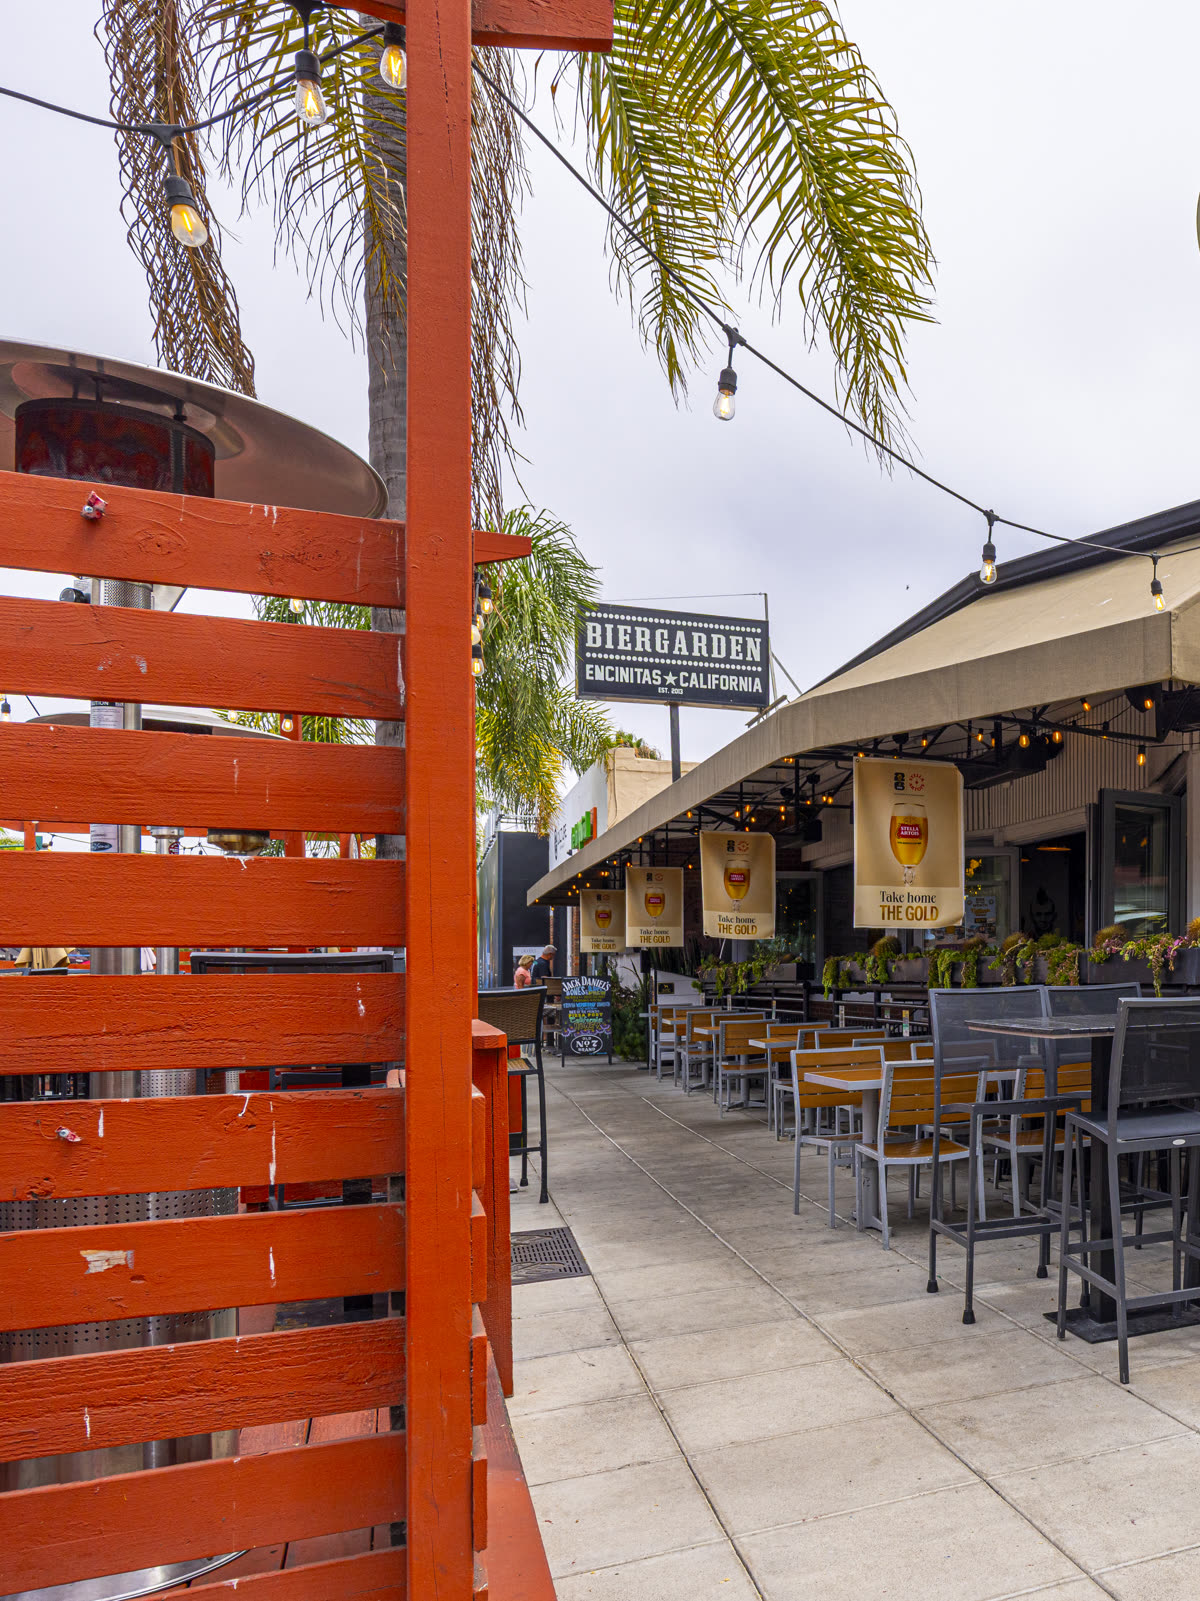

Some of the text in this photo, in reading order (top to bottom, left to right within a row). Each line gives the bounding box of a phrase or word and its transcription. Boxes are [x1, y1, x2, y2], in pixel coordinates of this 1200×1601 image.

[585, 621, 762, 662] BIERGARDEN
[585, 664, 763, 693] ENCINITAS CALIFORNIA
[880, 890, 937, 904] Take home
[718, 914, 756, 924] Take home
[880, 904, 939, 922] THE GOLD
[717, 922, 758, 935] THE GOLD
[639, 935, 652, 943] THE
[562, 979, 581, 993] JACK
[581, 976, 612, 992] DANIEL'S
